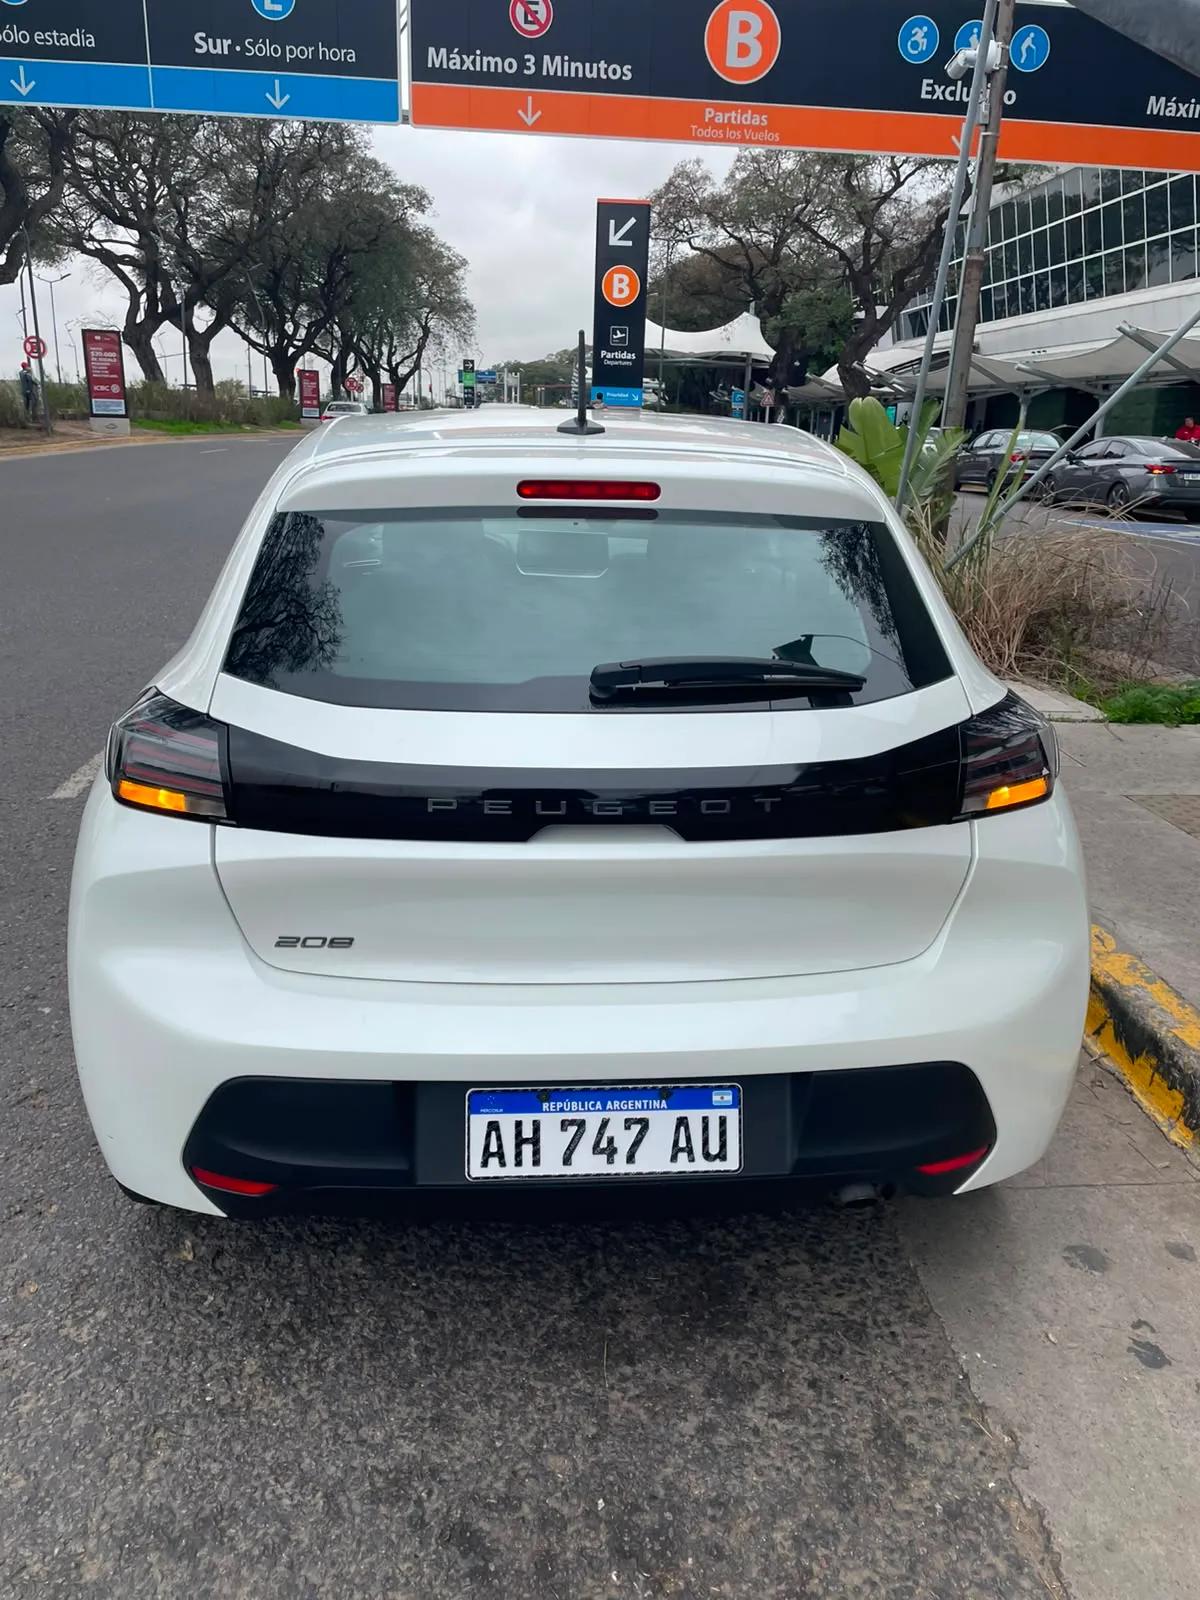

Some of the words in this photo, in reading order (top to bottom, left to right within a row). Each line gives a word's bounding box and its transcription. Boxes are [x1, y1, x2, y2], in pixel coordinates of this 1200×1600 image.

[0, 24, 30, 43] ólo
[34, 28, 96, 47] estadía
[725, 10, 763, 68] B
[194, 32, 232, 55] Sur
[245, 39, 282, 58] Sólo
[286, 44, 316, 62] por
[319, 46, 356, 63] hora
[427, 47, 518, 75] Máximo
[523, 54, 536, 75] 3
[542, 55, 633, 81] Minutos
[920, 79, 1017, 105] Excluio
[704, 108, 768, 126] Partidas
[690, 125, 723, 140] Todos
[726, 126, 741, 141] los
[743, 128, 780, 142] Vuelos
[611, 273, 630, 299] B
[600, 350, 636, 360] Partidas
[427, 797, 783, 816] PEUGEOT
[274, 935, 355, 949] 208
[542, 1099, 602, 1112] REPÚBLICA
[606, 1099, 668, 1111] ARGENTINA
[480, 1119, 541, 1168] AH
[560, 1117, 650, 1167] 747
[670, 1115, 727, 1163] AU
